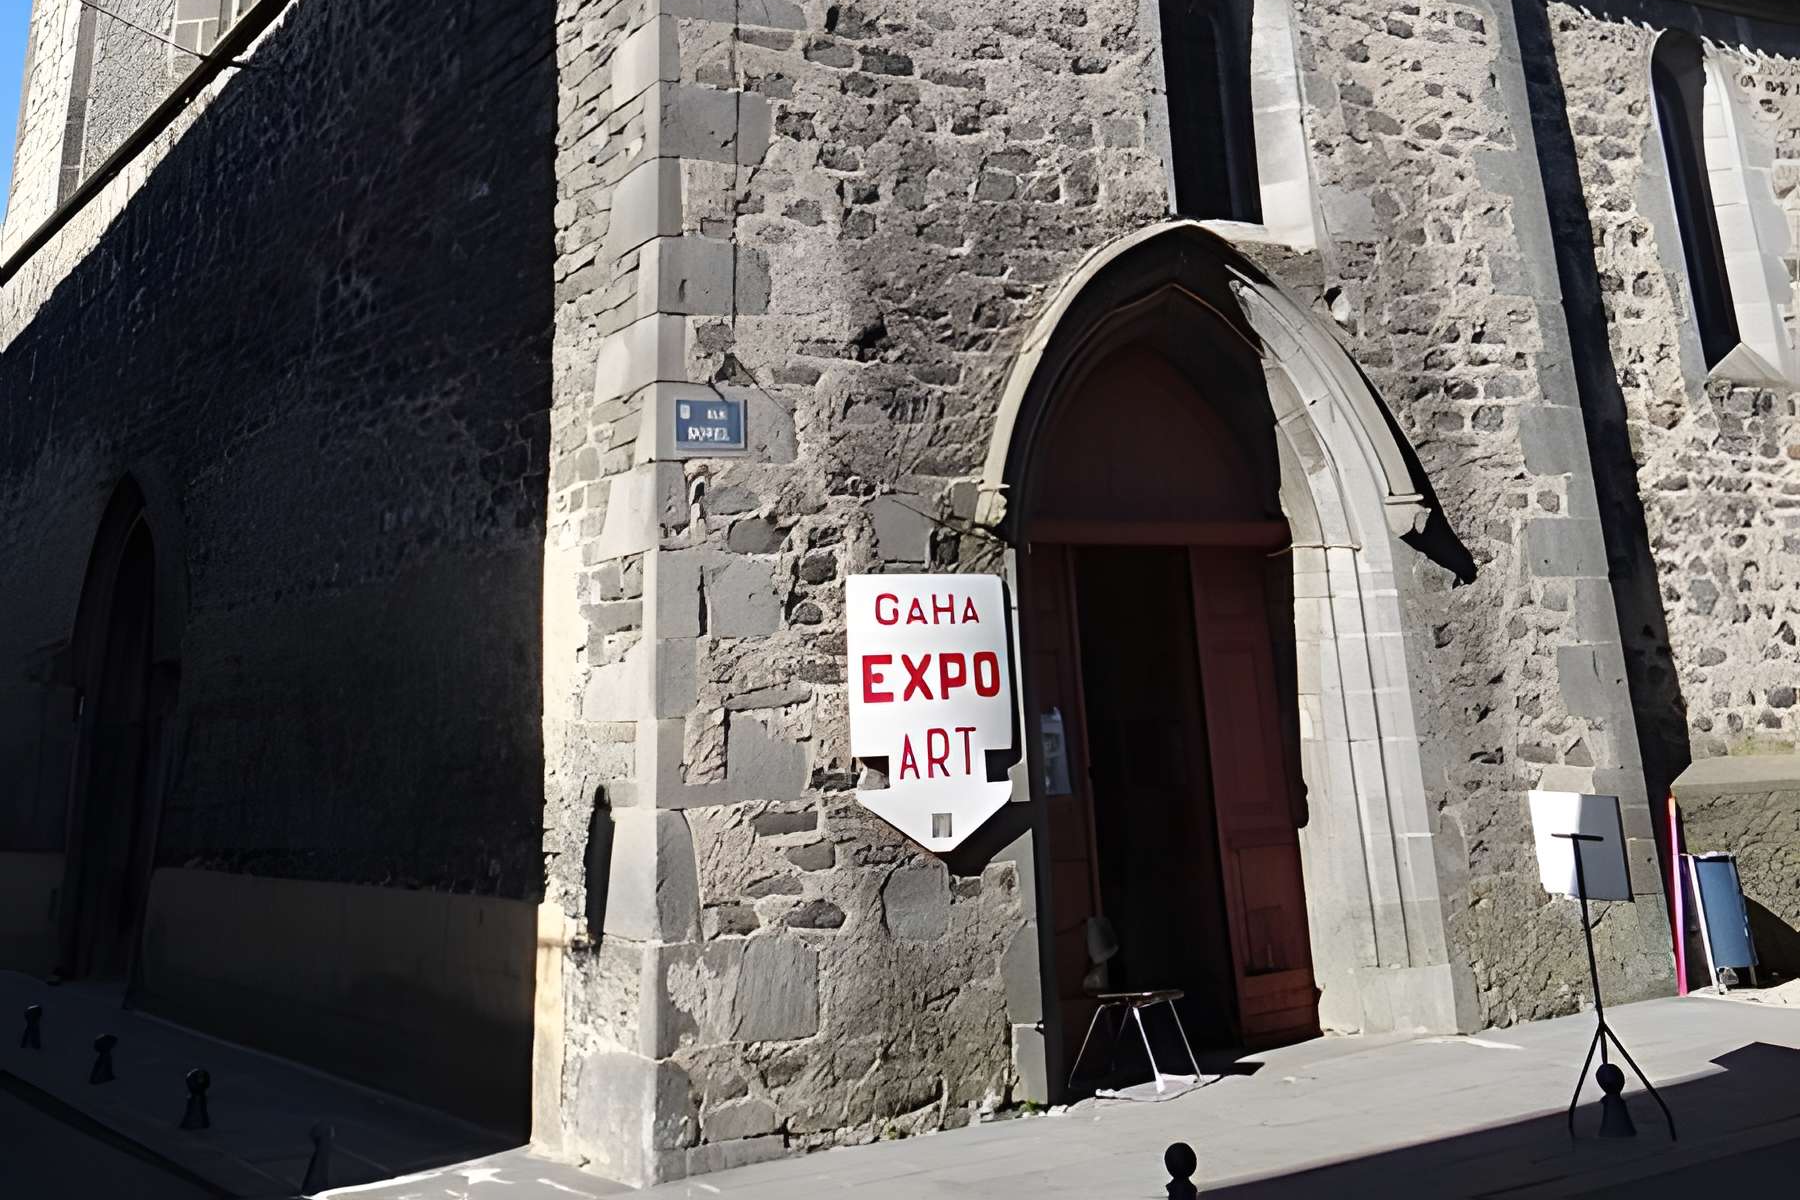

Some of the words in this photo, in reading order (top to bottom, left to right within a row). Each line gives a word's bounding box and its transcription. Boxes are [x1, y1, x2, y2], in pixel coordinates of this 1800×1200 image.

[874, 592, 980, 625] GAHA
[861, 651, 1001, 703] EXPO
[899, 726, 977, 780] ART
